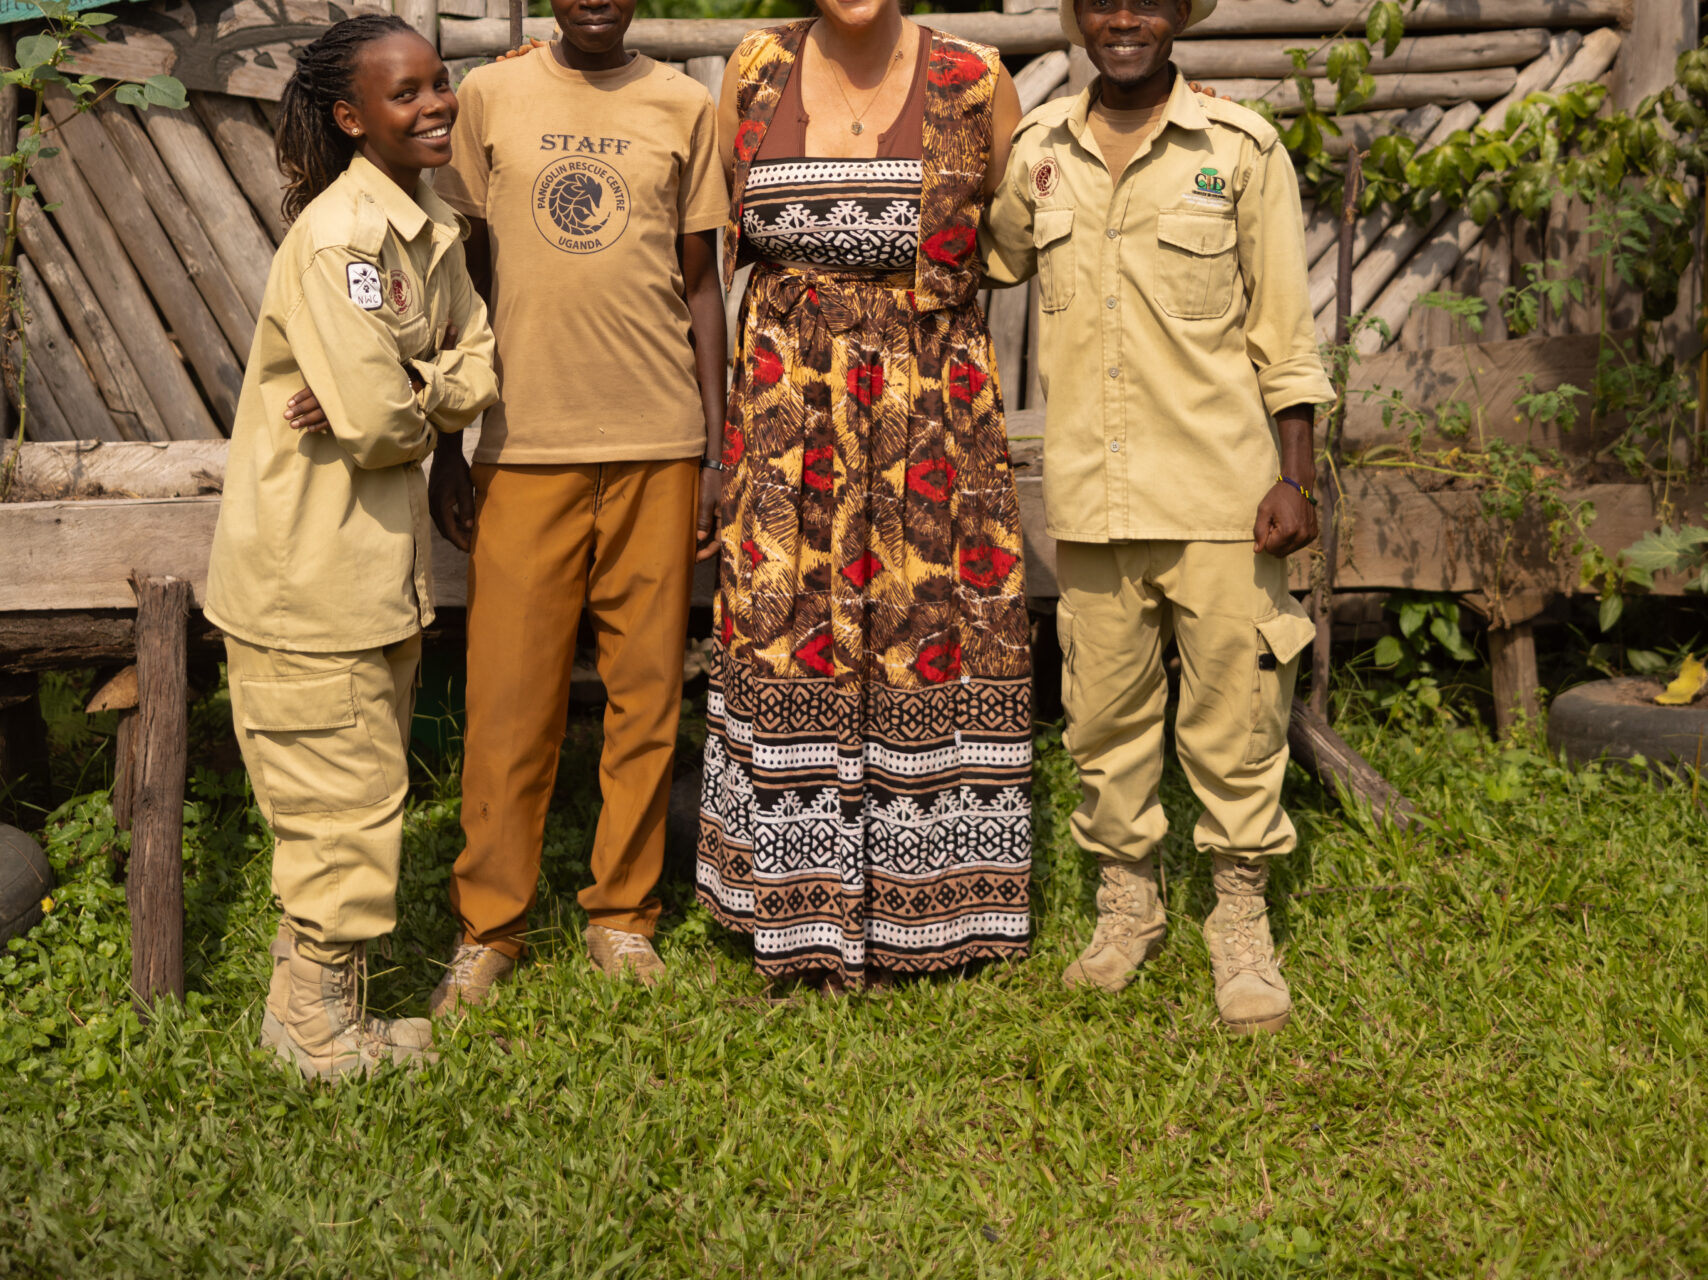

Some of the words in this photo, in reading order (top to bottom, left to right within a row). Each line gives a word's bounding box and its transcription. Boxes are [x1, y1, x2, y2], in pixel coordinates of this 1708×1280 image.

[540, 133, 632, 156] STAFF
[537, 163, 568, 210] PANGOLIN
[568, 161, 608, 179] RESCUE
[605, 175, 626, 212] CENTRE
[558, 236, 603, 250] UGANDA
[357, 294, 379, 305] NWC
